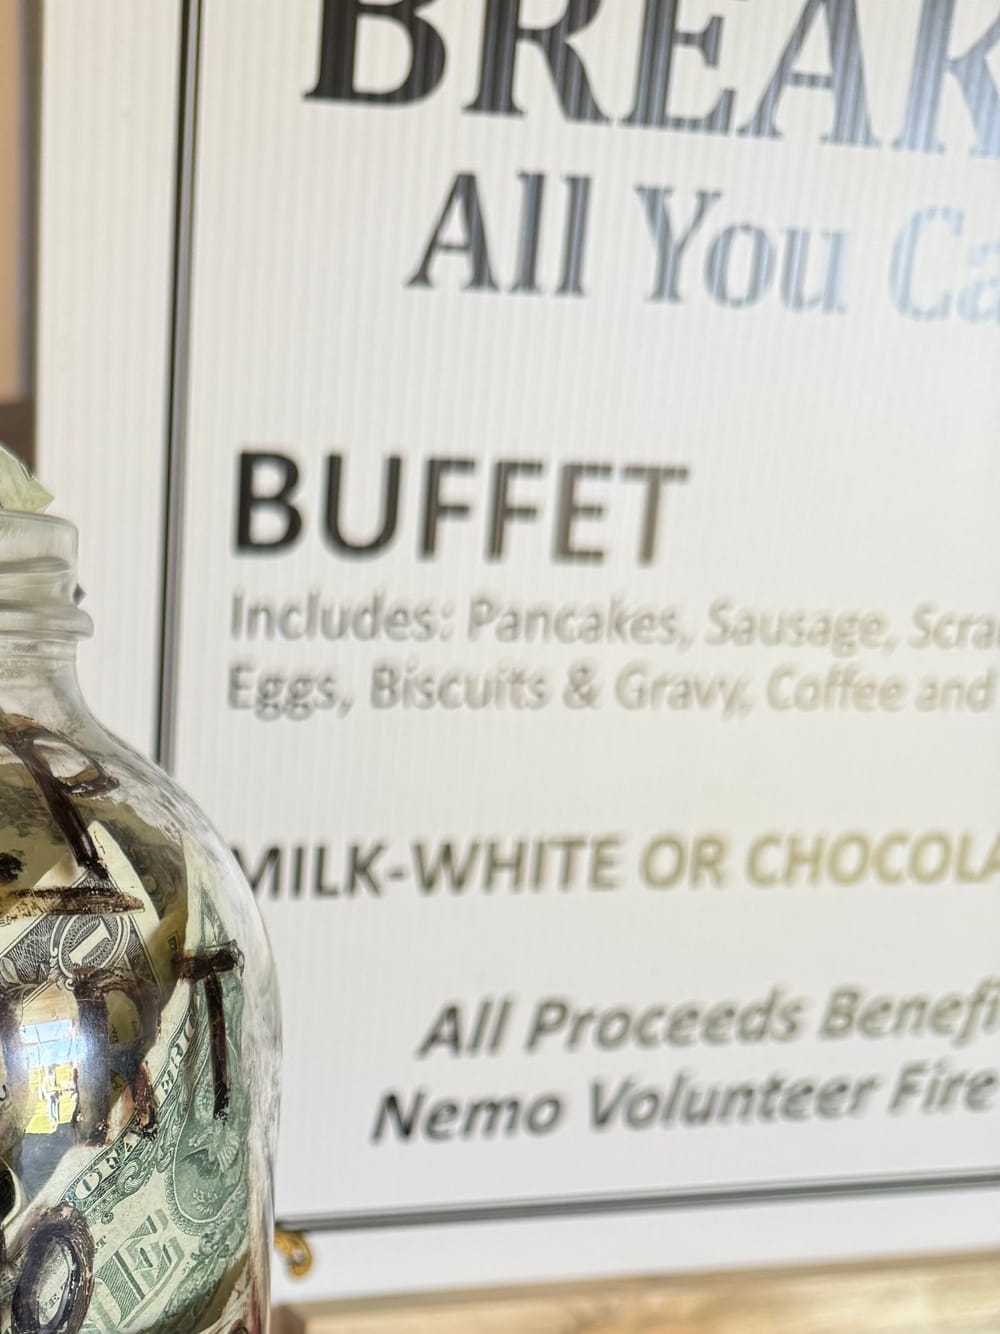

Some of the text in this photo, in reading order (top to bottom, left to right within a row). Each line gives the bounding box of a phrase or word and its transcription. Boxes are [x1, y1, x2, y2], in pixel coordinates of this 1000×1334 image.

[302, 0, 1000, 158] BREAK
[405, 168, 1000, 324] All You Ca
[229, 448, 691, 568] BUFFET
[228, 591, 1000, 657] Includes: Pancakes, Sausage, Scra
[227, 662, 353, 722] Eggs,
[370, 664, 548, 713] Biscuits
[562, 666, 600, 711] &
[765, 667, 904, 713] Coffee
[917, 665, 997, 713] and
[230, 836, 619, 900] MILK-WHITE
[638, 832, 725, 892] OR
[415, 993, 513, 1058] All
[525, 982, 804, 1054] Proceeds
[370, 1055, 999, 1146] Nemo Volunteer Fire
